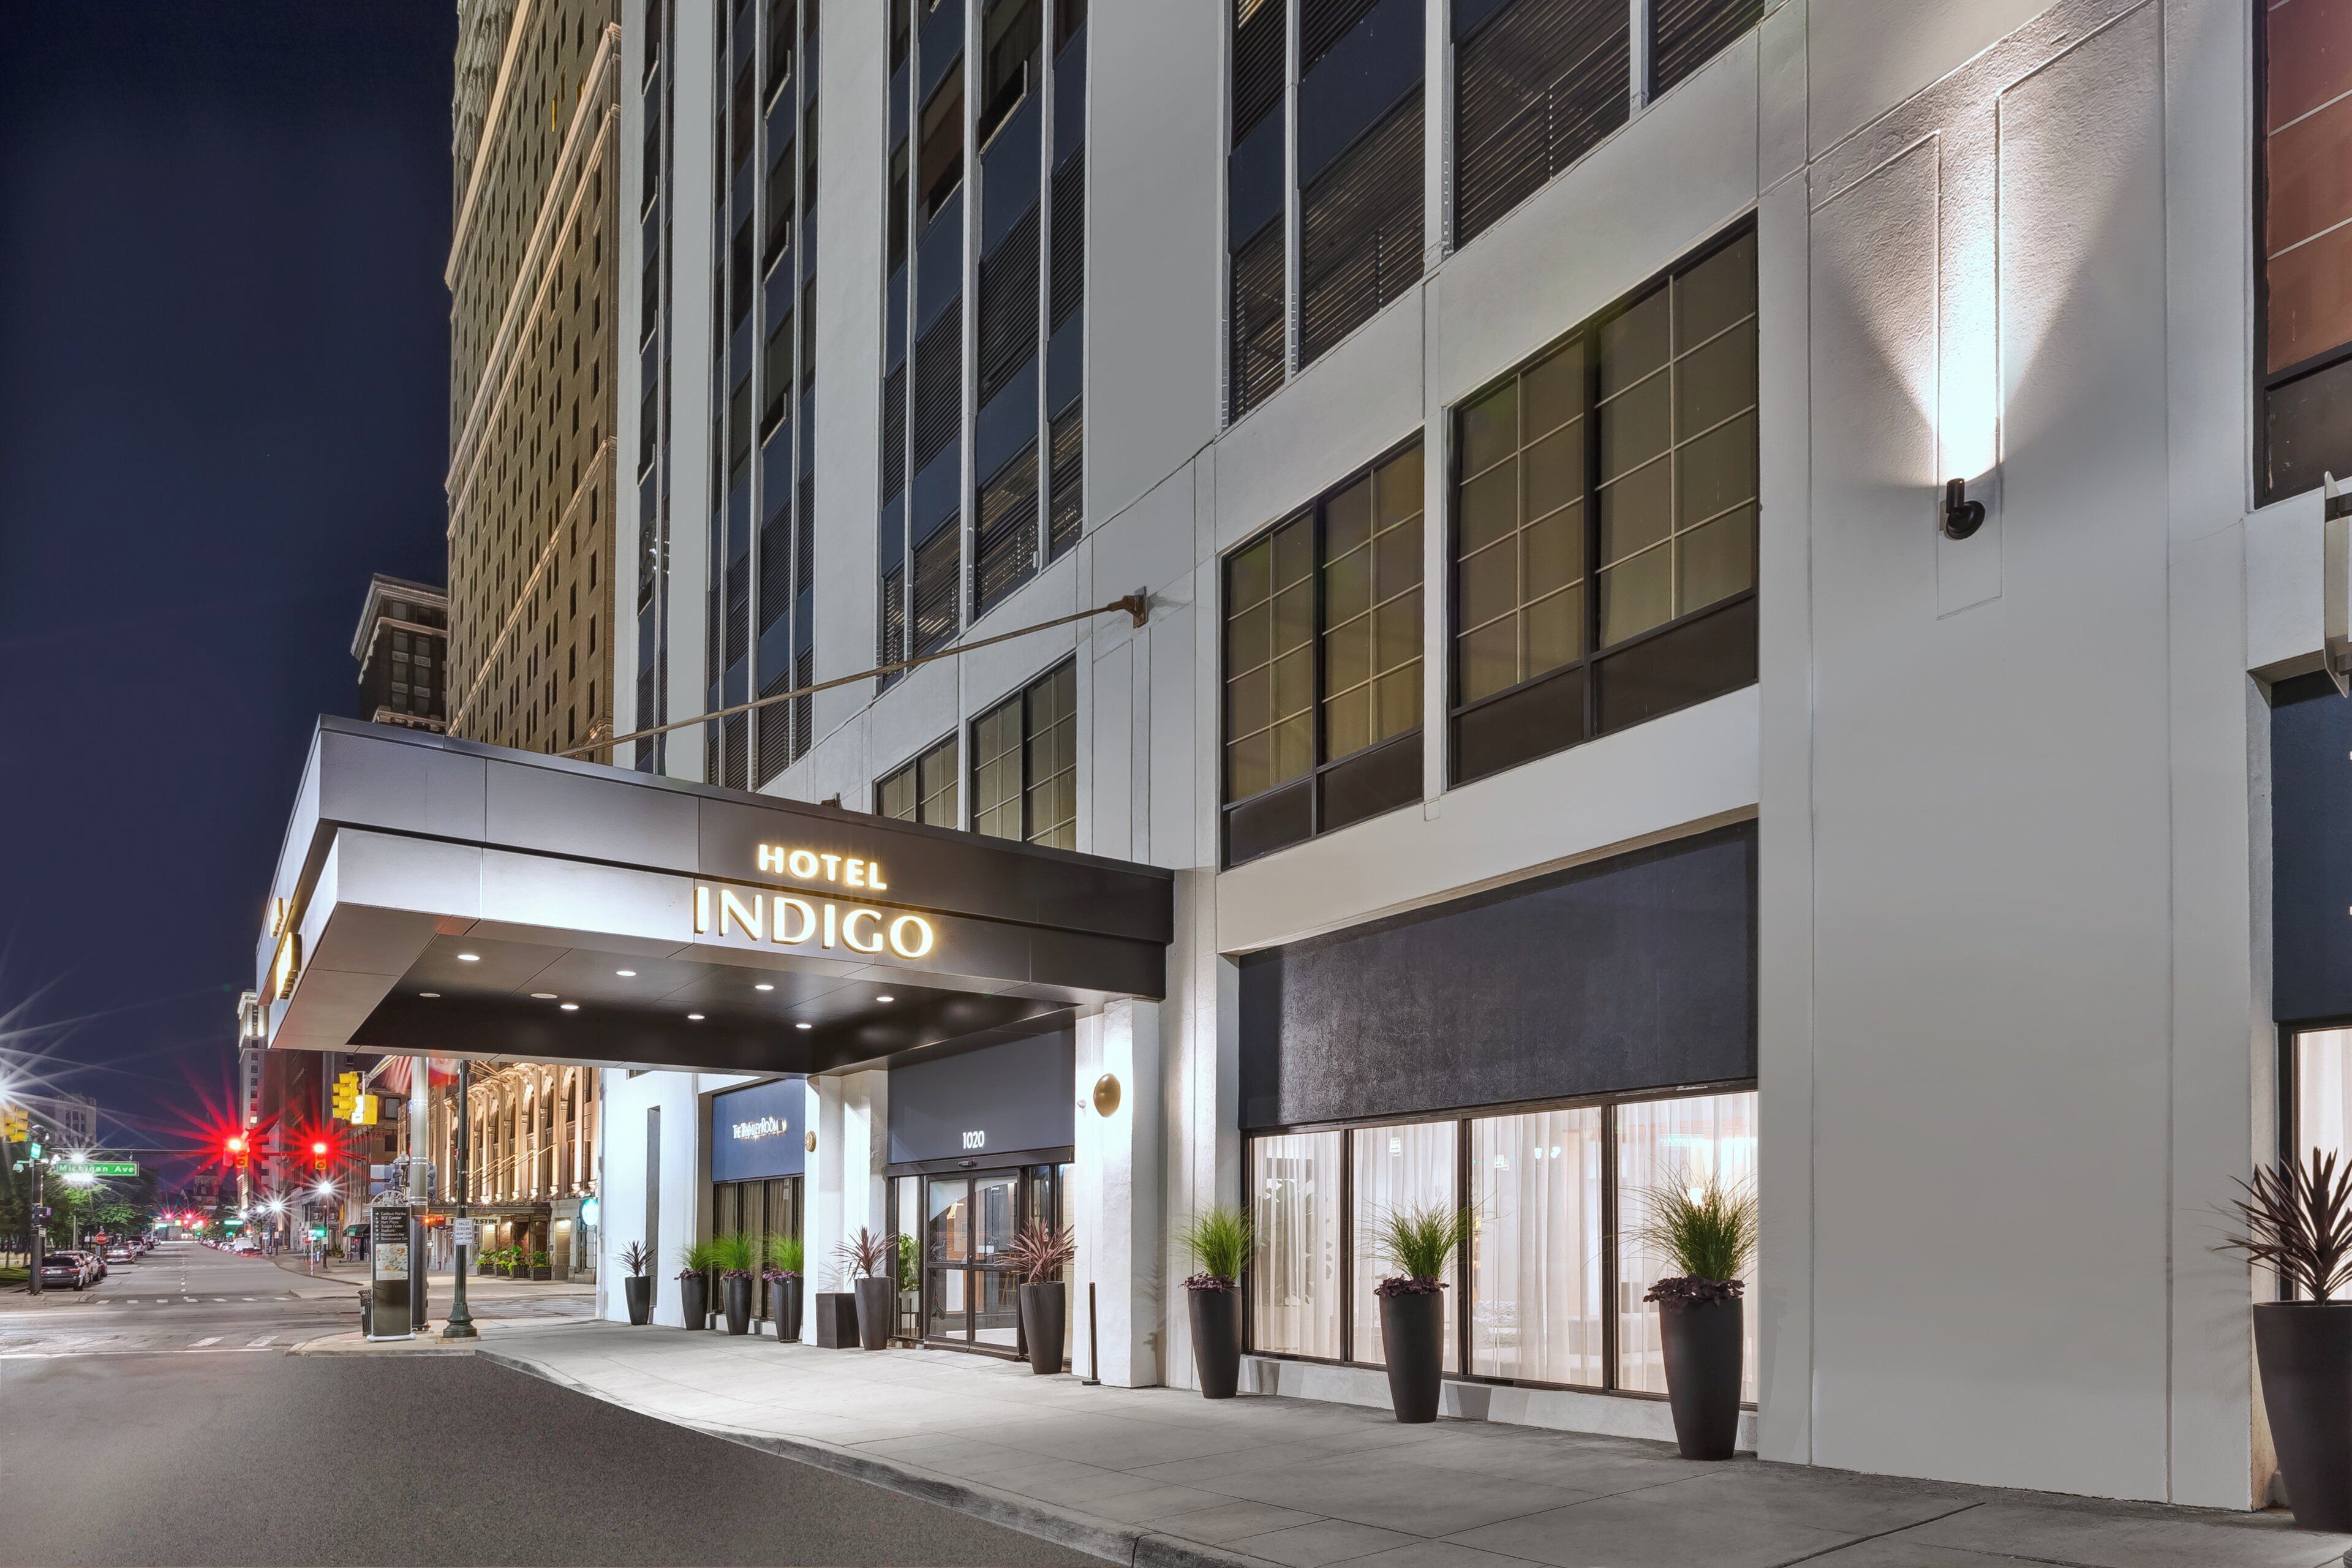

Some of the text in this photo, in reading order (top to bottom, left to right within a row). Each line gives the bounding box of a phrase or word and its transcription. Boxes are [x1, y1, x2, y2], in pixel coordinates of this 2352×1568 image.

[758, 844, 888, 890] HOTEL
[695, 886, 933, 959] INDIGO
[962, 1130, 985, 1150] 1020
[59, 1164, 108, 1174] Michigan
